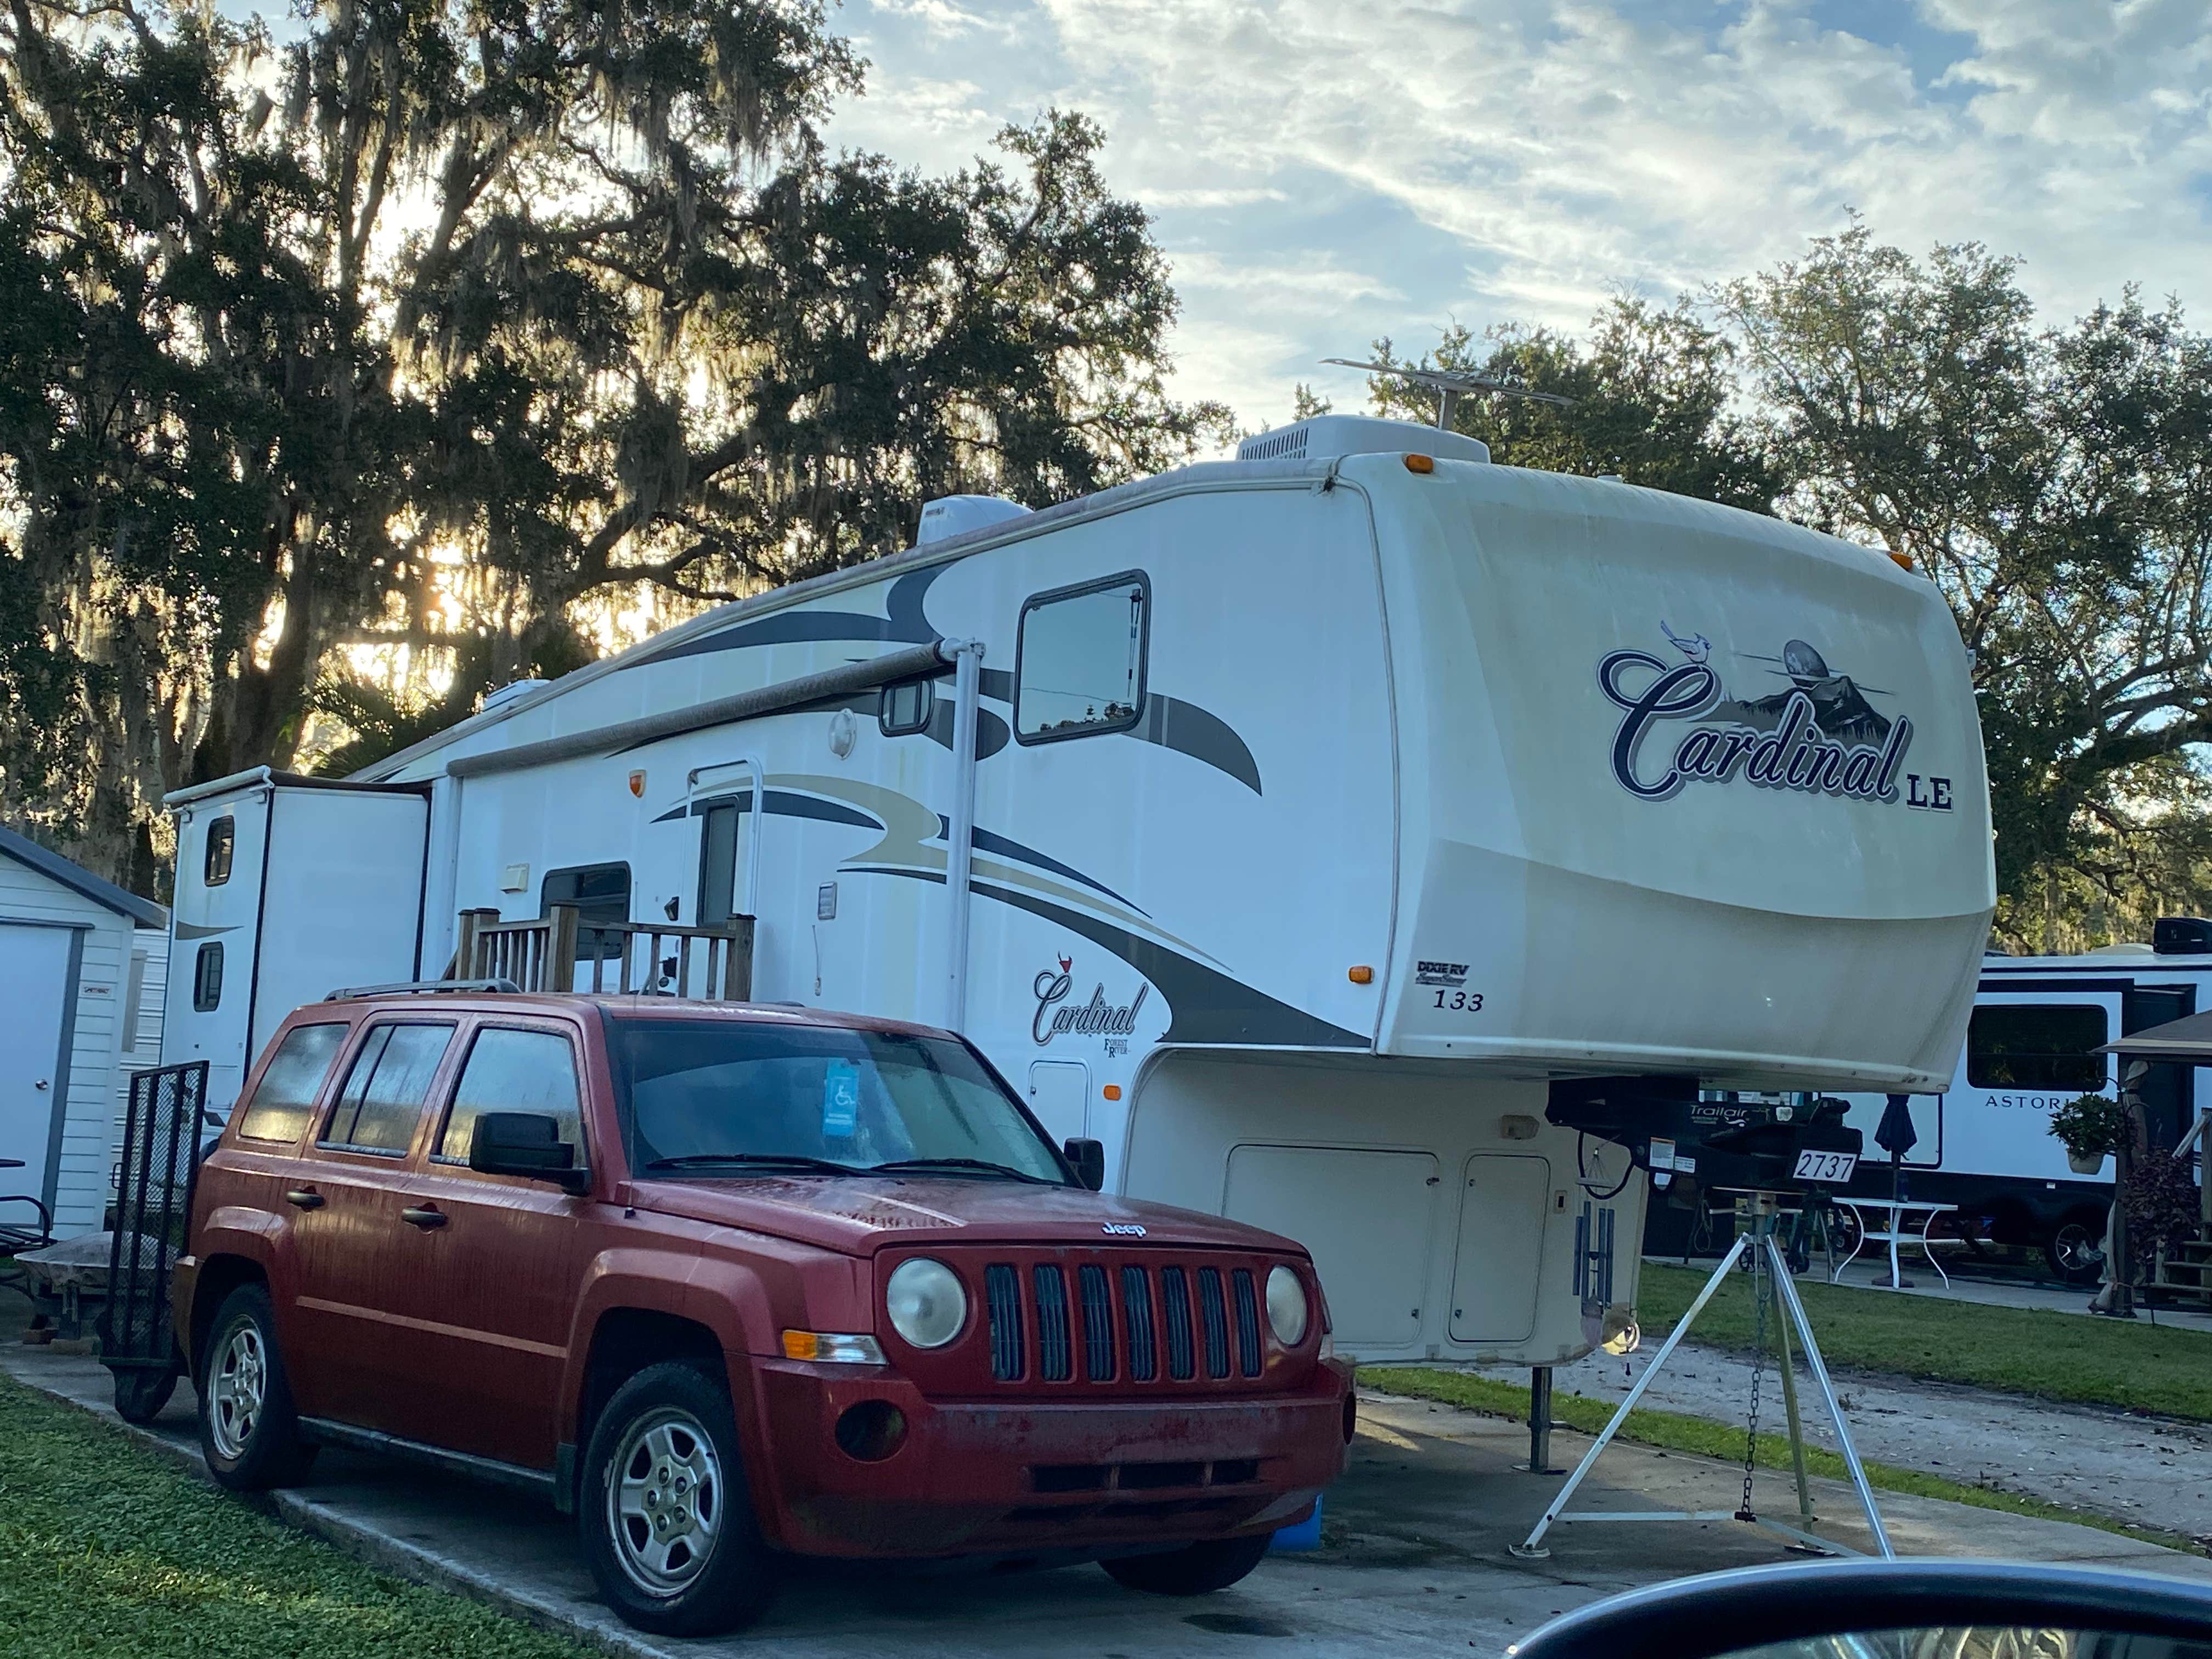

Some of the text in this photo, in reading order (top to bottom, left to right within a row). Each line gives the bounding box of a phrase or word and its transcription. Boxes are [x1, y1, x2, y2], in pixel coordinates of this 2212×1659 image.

[1597, 649, 1954, 812] Cardinal LE
[1417, 960, 1470, 976] DIXIE RV
[1032, 969, 1149, 1046] Cardinal
[1433, 989, 1485, 1012] 133
[1797, 1153, 1854, 1180] 2737
[1102, 1221, 1147, 1238] Jeep
